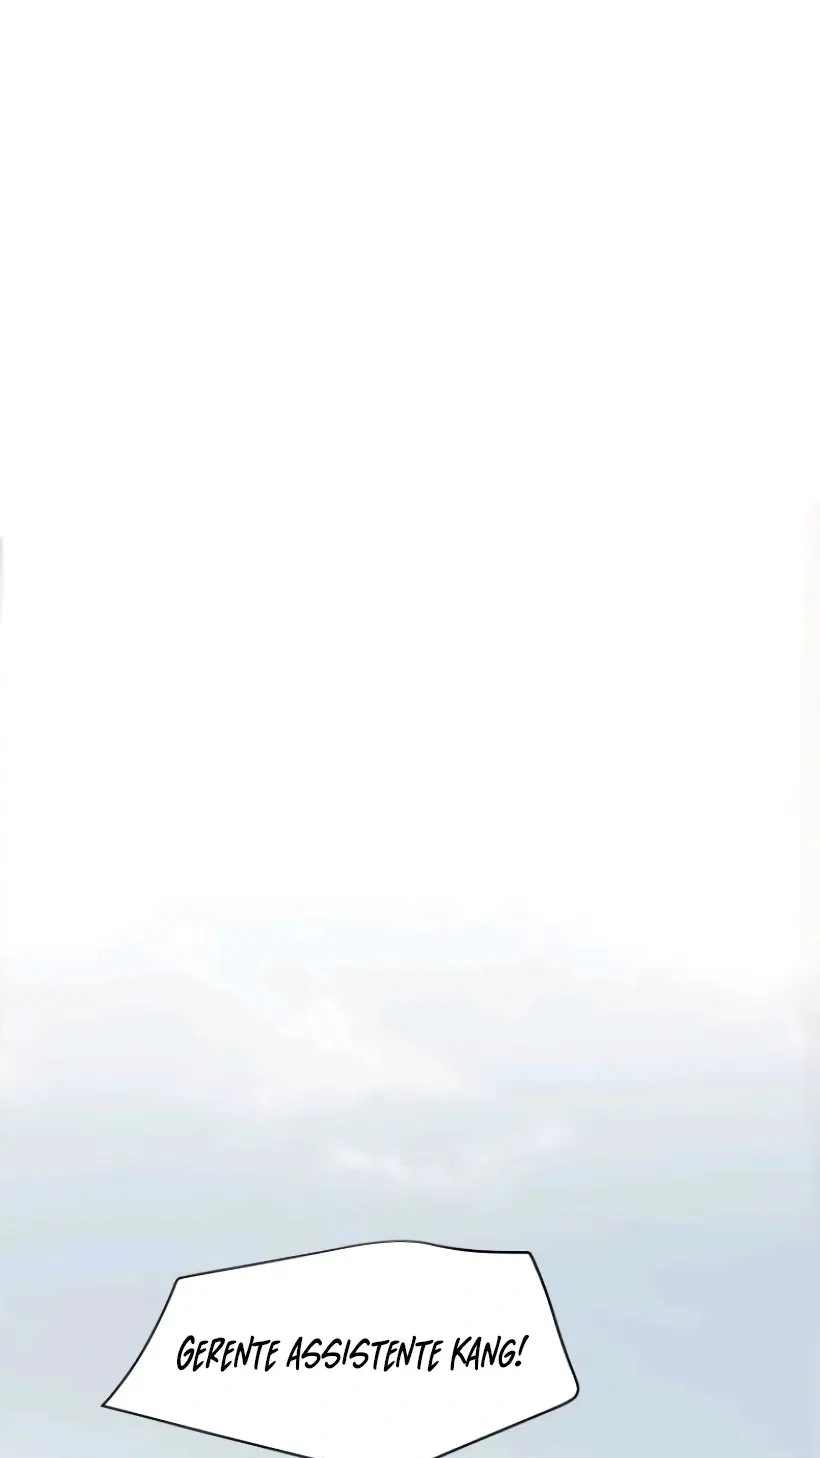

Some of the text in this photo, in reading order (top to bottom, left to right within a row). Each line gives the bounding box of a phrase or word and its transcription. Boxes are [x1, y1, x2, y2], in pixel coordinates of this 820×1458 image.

[176, 1334, 530, 1373] GERENTE ASSISTENTE KANG!
